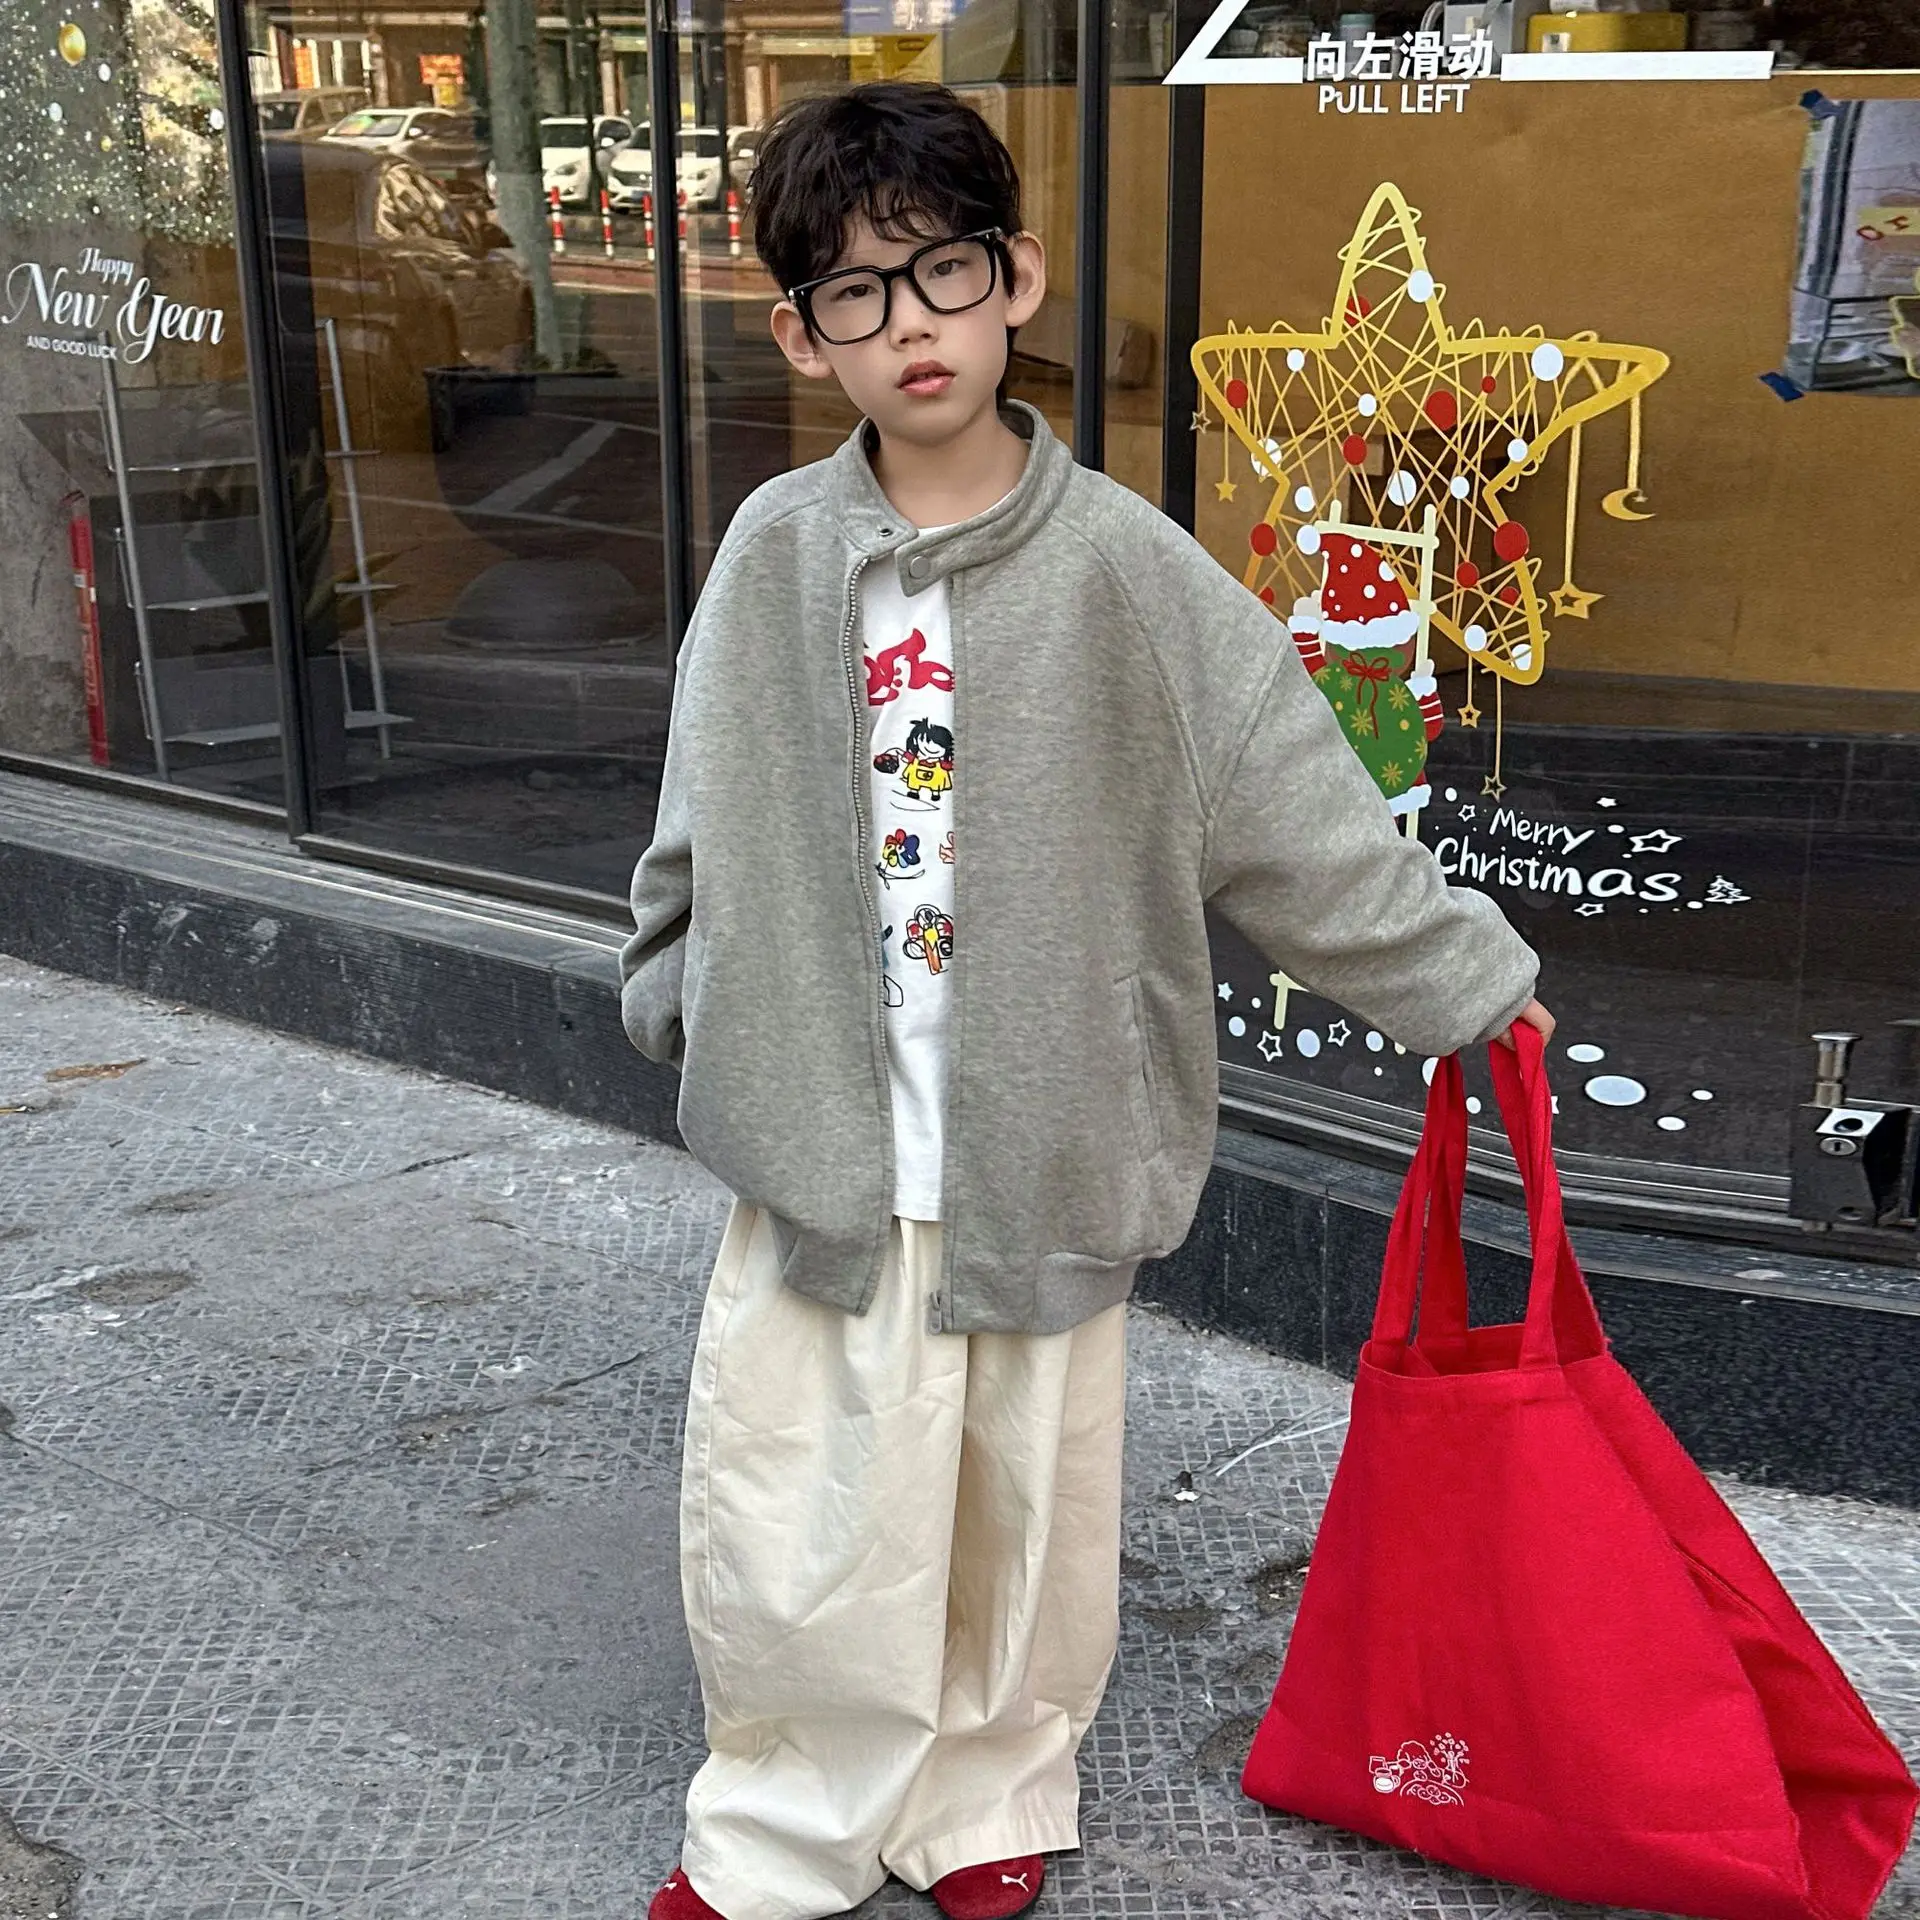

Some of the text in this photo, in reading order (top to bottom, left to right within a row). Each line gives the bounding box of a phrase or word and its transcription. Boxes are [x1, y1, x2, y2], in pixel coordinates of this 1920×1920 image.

[1306, 28, 1494, 82] 向左滑动
[1318, 83, 1471, 114] PULL LEFT
[77, 247, 135, 286] Happy
[0, 262, 225, 365] New Year
[26, 335, 118, 361] AND GOOD LUCK
[1489, 807, 1596, 855] Merry
[1434, 834, 1682, 902] Christmas
